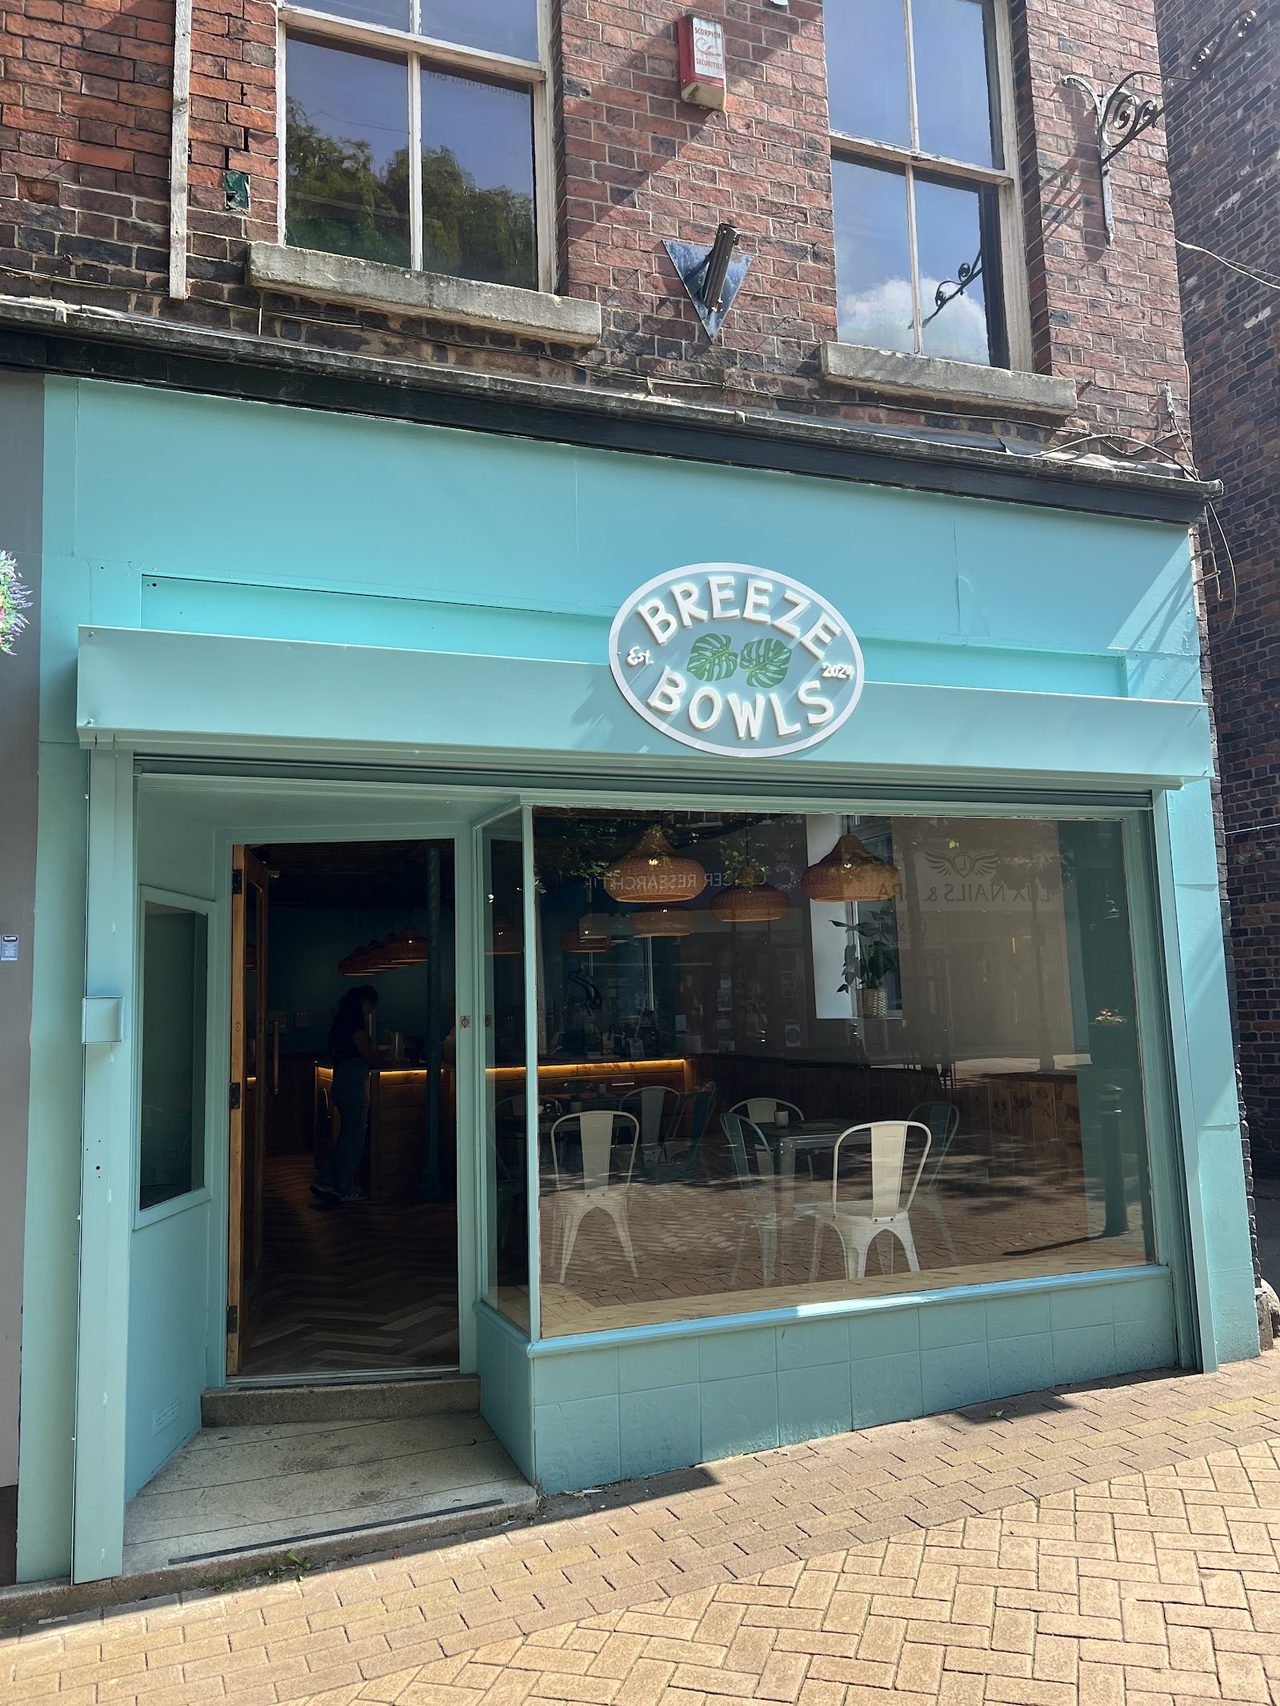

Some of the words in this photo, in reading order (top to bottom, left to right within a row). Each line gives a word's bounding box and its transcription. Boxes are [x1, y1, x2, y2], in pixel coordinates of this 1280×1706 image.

[694, 27, 721, 39] SCORPION
[637, 575, 842, 661] BREEZE
[647, 666, 835, 740] BOWLS
